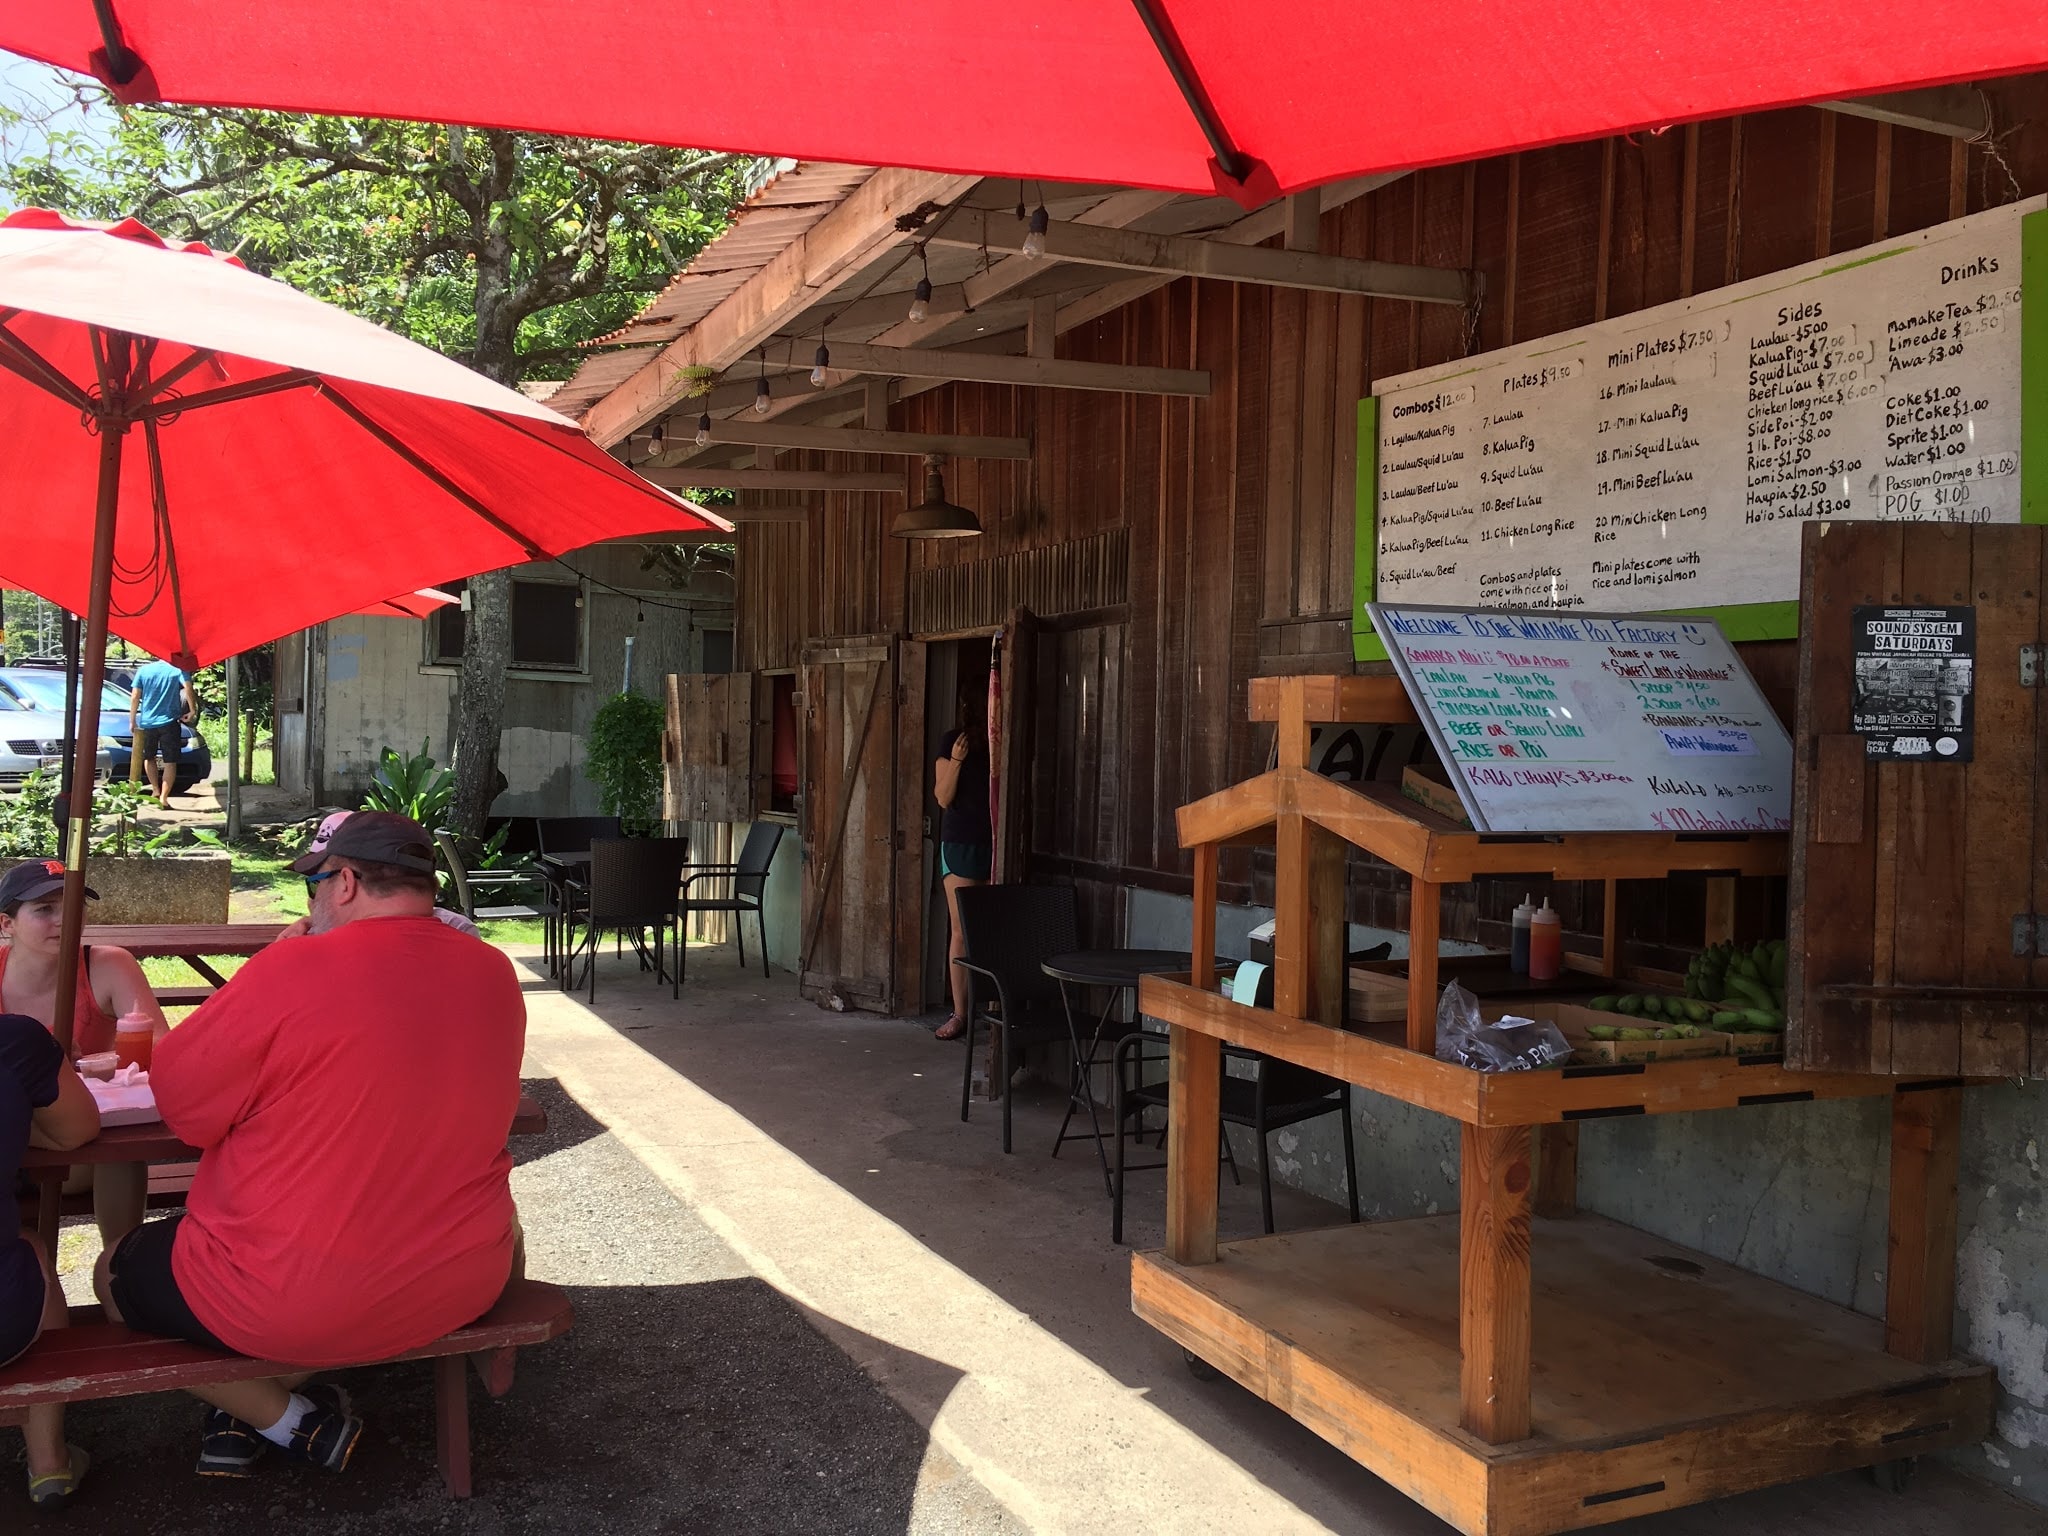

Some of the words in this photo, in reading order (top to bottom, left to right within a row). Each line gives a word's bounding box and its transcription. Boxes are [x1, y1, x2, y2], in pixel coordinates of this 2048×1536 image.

[1778, 303, 1822, 326] Sides
[1945, 301, 1973, 319] Tea
[1636, 337, 1676, 361] Plates
[1678, 329, 1713, 353] $7.50
[1889, 326, 1947, 352] Limeade
[1504, 373, 1538, 393] Plates
[1749, 365, 1784, 386] Squid
[1616, 379, 1638, 398] Mini
[1749, 383, 1778, 402] Beef
[1924, 385, 1961, 402] $1.00
[1393, 401, 1434, 418] Combos
[1748, 400, 1787, 419] Chicken
[1789, 397, 1811, 413] long
[1813, 393, 1833, 406] rice
[1886, 410, 1913, 428] Diet
[1953, 398, 1990, 419] $1.00
[1483, 417, 1491, 429] 7.
[1494, 410, 1524, 424] Laulau
[1617, 414, 1637, 430] Mini
[1672, 403, 1688, 422] Pig
[1443, 424, 1455, 436] Pig
[1748, 417, 1775, 438] Side
[1887, 430, 1928, 449] Sprite
[1930, 423, 1964, 442] $1.00
[1483, 444, 1491, 456] 8.
[1519, 435, 1535, 452] Pig
[1597, 450, 1610, 465] 18.
[1613, 444, 1632, 461] Mini
[1635, 437, 1664, 459] Squid
[1747, 441, 1753, 454] 1
[1885, 452, 1925, 468] Water
[1927, 442, 1966, 464] $1.00
[1480, 472, 1490, 484] 9.
[1491, 467, 1516, 484] Squid
[1598, 481, 1612, 496] 19.
[1613, 476, 1634, 492] Mini
[1636, 473, 1661, 489] Beef
[1748, 472, 1775, 488] Lomi
[1886, 475, 1931, 492] Passion
[1933, 466, 1972, 484] Orange
[1977, 458, 2014, 480] $1.00
[1482, 501, 1493, 513] 10.
[1495, 498, 1516, 512] Beef
[1778, 501, 1813, 519] Salad
[1816, 498, 1851, 516] $3.00
[1885, 491, 1922, 515] POG
[1935, 485, 1970, 505] $1.00
[1611, 510, 1633, 526] Mini
[1633, 509, 1677, 525] Chicken
[1680, 505, 1707, 520] Long
[1481, 531, 1493, 542] 11.
[1494, 526, 1529, 539] Chicken
[1530, 521, 1553, 536] Long
[1554, 519, 1575, 531] Rice
[1594, 531, 1617, 543] Rice
[1592, 558, 1612, 574] Mini
[1614, 556, 1646, 575] plates
[1646, 554, 1673, 569] come
[1677, 551, 1701, 566] with
[1390, 568, 1411, 584] Squid
[1480, 572, 1515, 585] Combos
[1517, 568, 1533, 579] and
[1534, 566, 1561, 580] plates
[1592, 577, 1611, 590] rice
[1613, 572, 1632, 587] and
[1633, 572, 1655, 586] lomi
[1657, 568, 1696, 585] salmon
[1480, 588, 1503, 598] come
[1505, 585, 1523, 595] with
[1525, 584, 1541, 595] rice
[1532, 596, 1549, 608] and
[1383, 611, 1462, 635] WELCOME
[1611, 620, 1677, 643] FACTORY
[1868, 623, 1909, 633] SOUND
[1608, 646, 1640, 658] HOME
[1659, 650, 1680, 659] THE
[1876, 636, 1952, 650] SATURDAYS
[1406, 646, 1456, 663] KANAKA
[1489, 701, 1522, 717] LONG
[1487, 724, 1508, 737] OR
[1498, 744, 1520, 757] OR
[1519, 739, 1548, 758] POI
